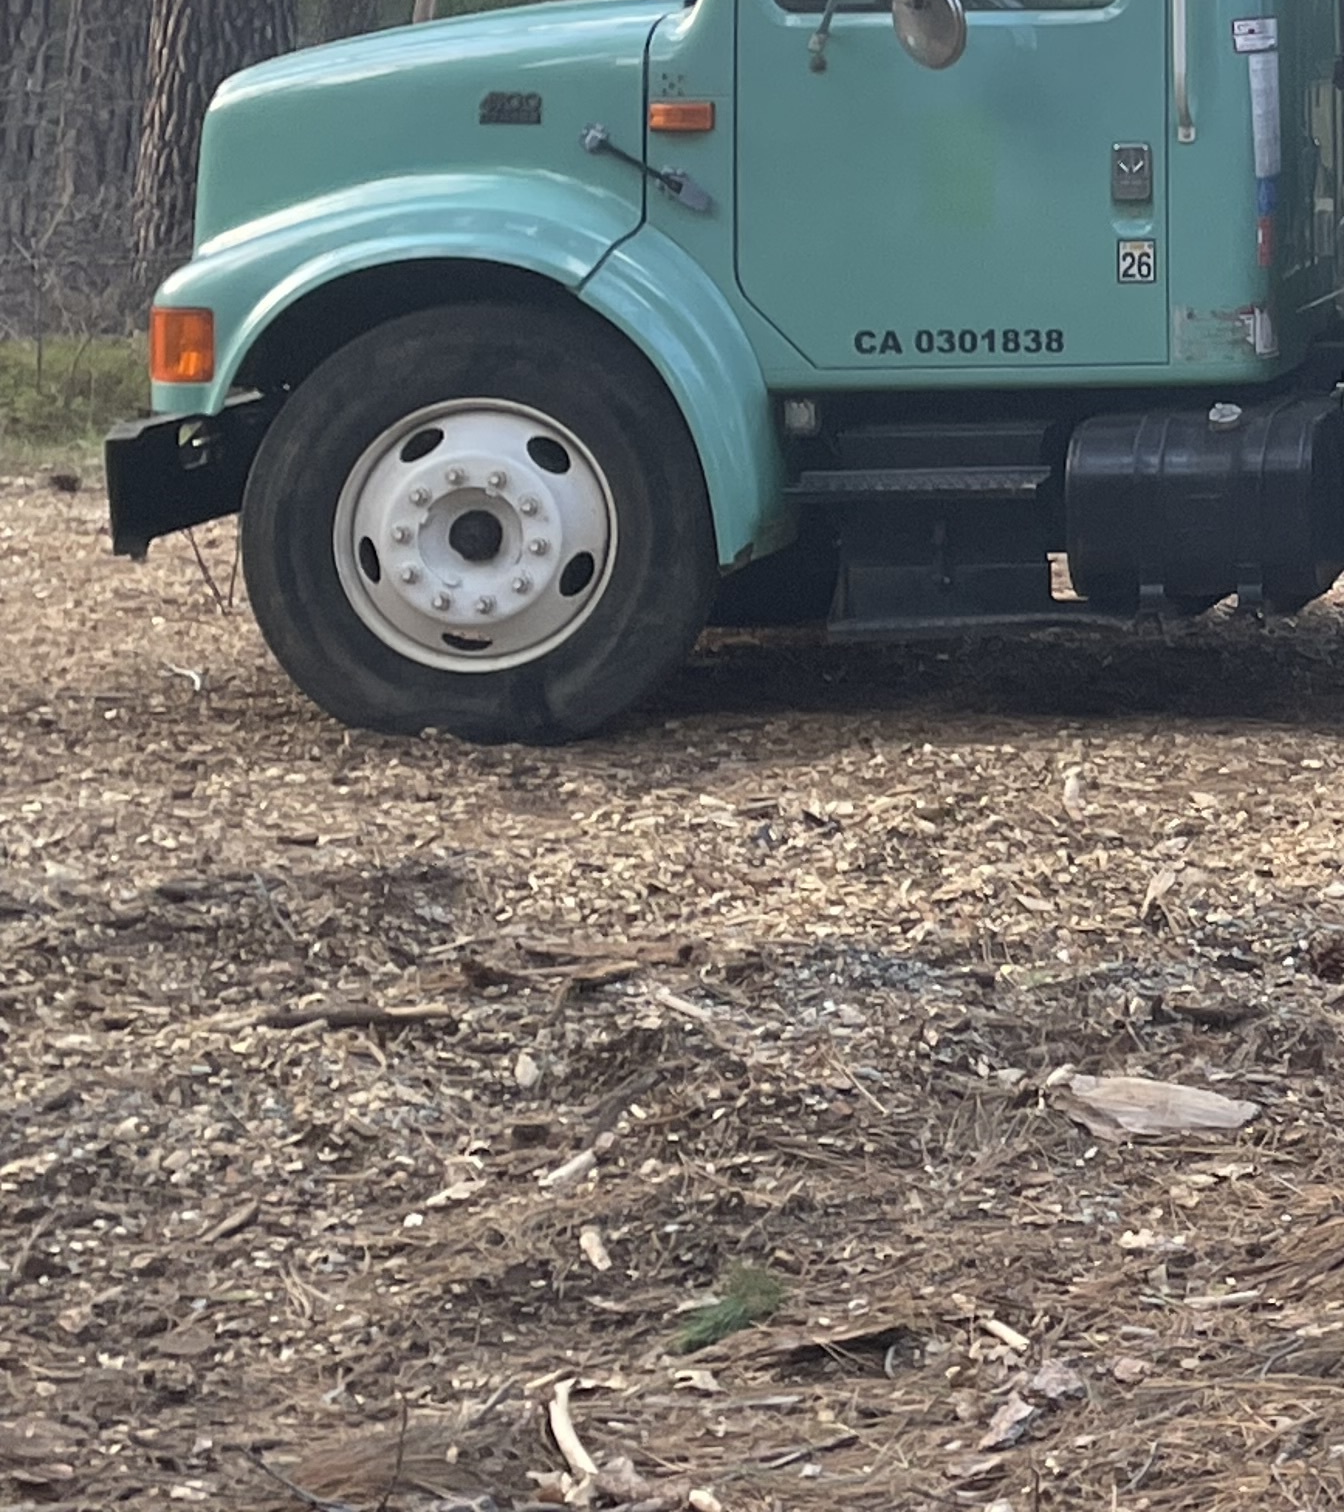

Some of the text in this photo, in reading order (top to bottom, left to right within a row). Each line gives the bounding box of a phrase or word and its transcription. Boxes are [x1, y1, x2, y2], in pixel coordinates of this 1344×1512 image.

[1121, 251, 1152, 279] 26
[854, 329, 1064, 354] CA 0301838
